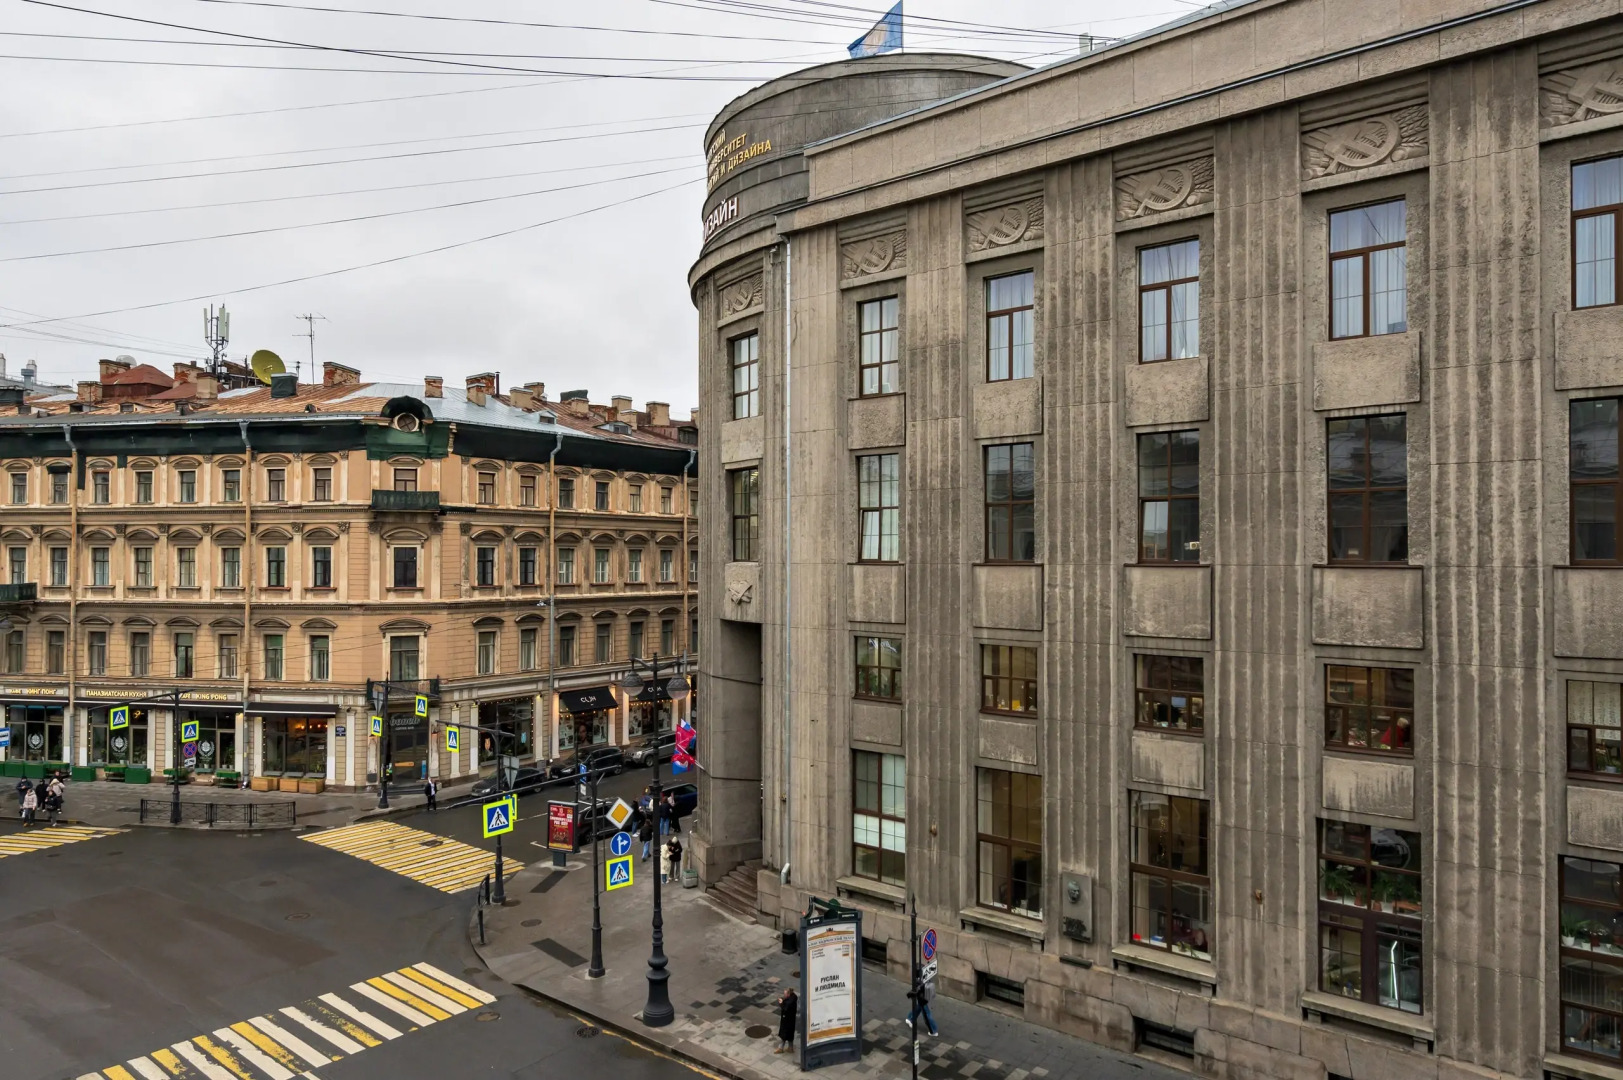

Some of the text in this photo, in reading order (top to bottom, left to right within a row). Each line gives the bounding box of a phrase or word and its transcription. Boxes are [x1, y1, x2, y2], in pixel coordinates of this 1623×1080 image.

[728, 139, 772, 173] ДИЗАЙНА
[820, 975, 840, 983] РУСЛАН
[819, 982, 846, 991] ЛЮДМИЛА
